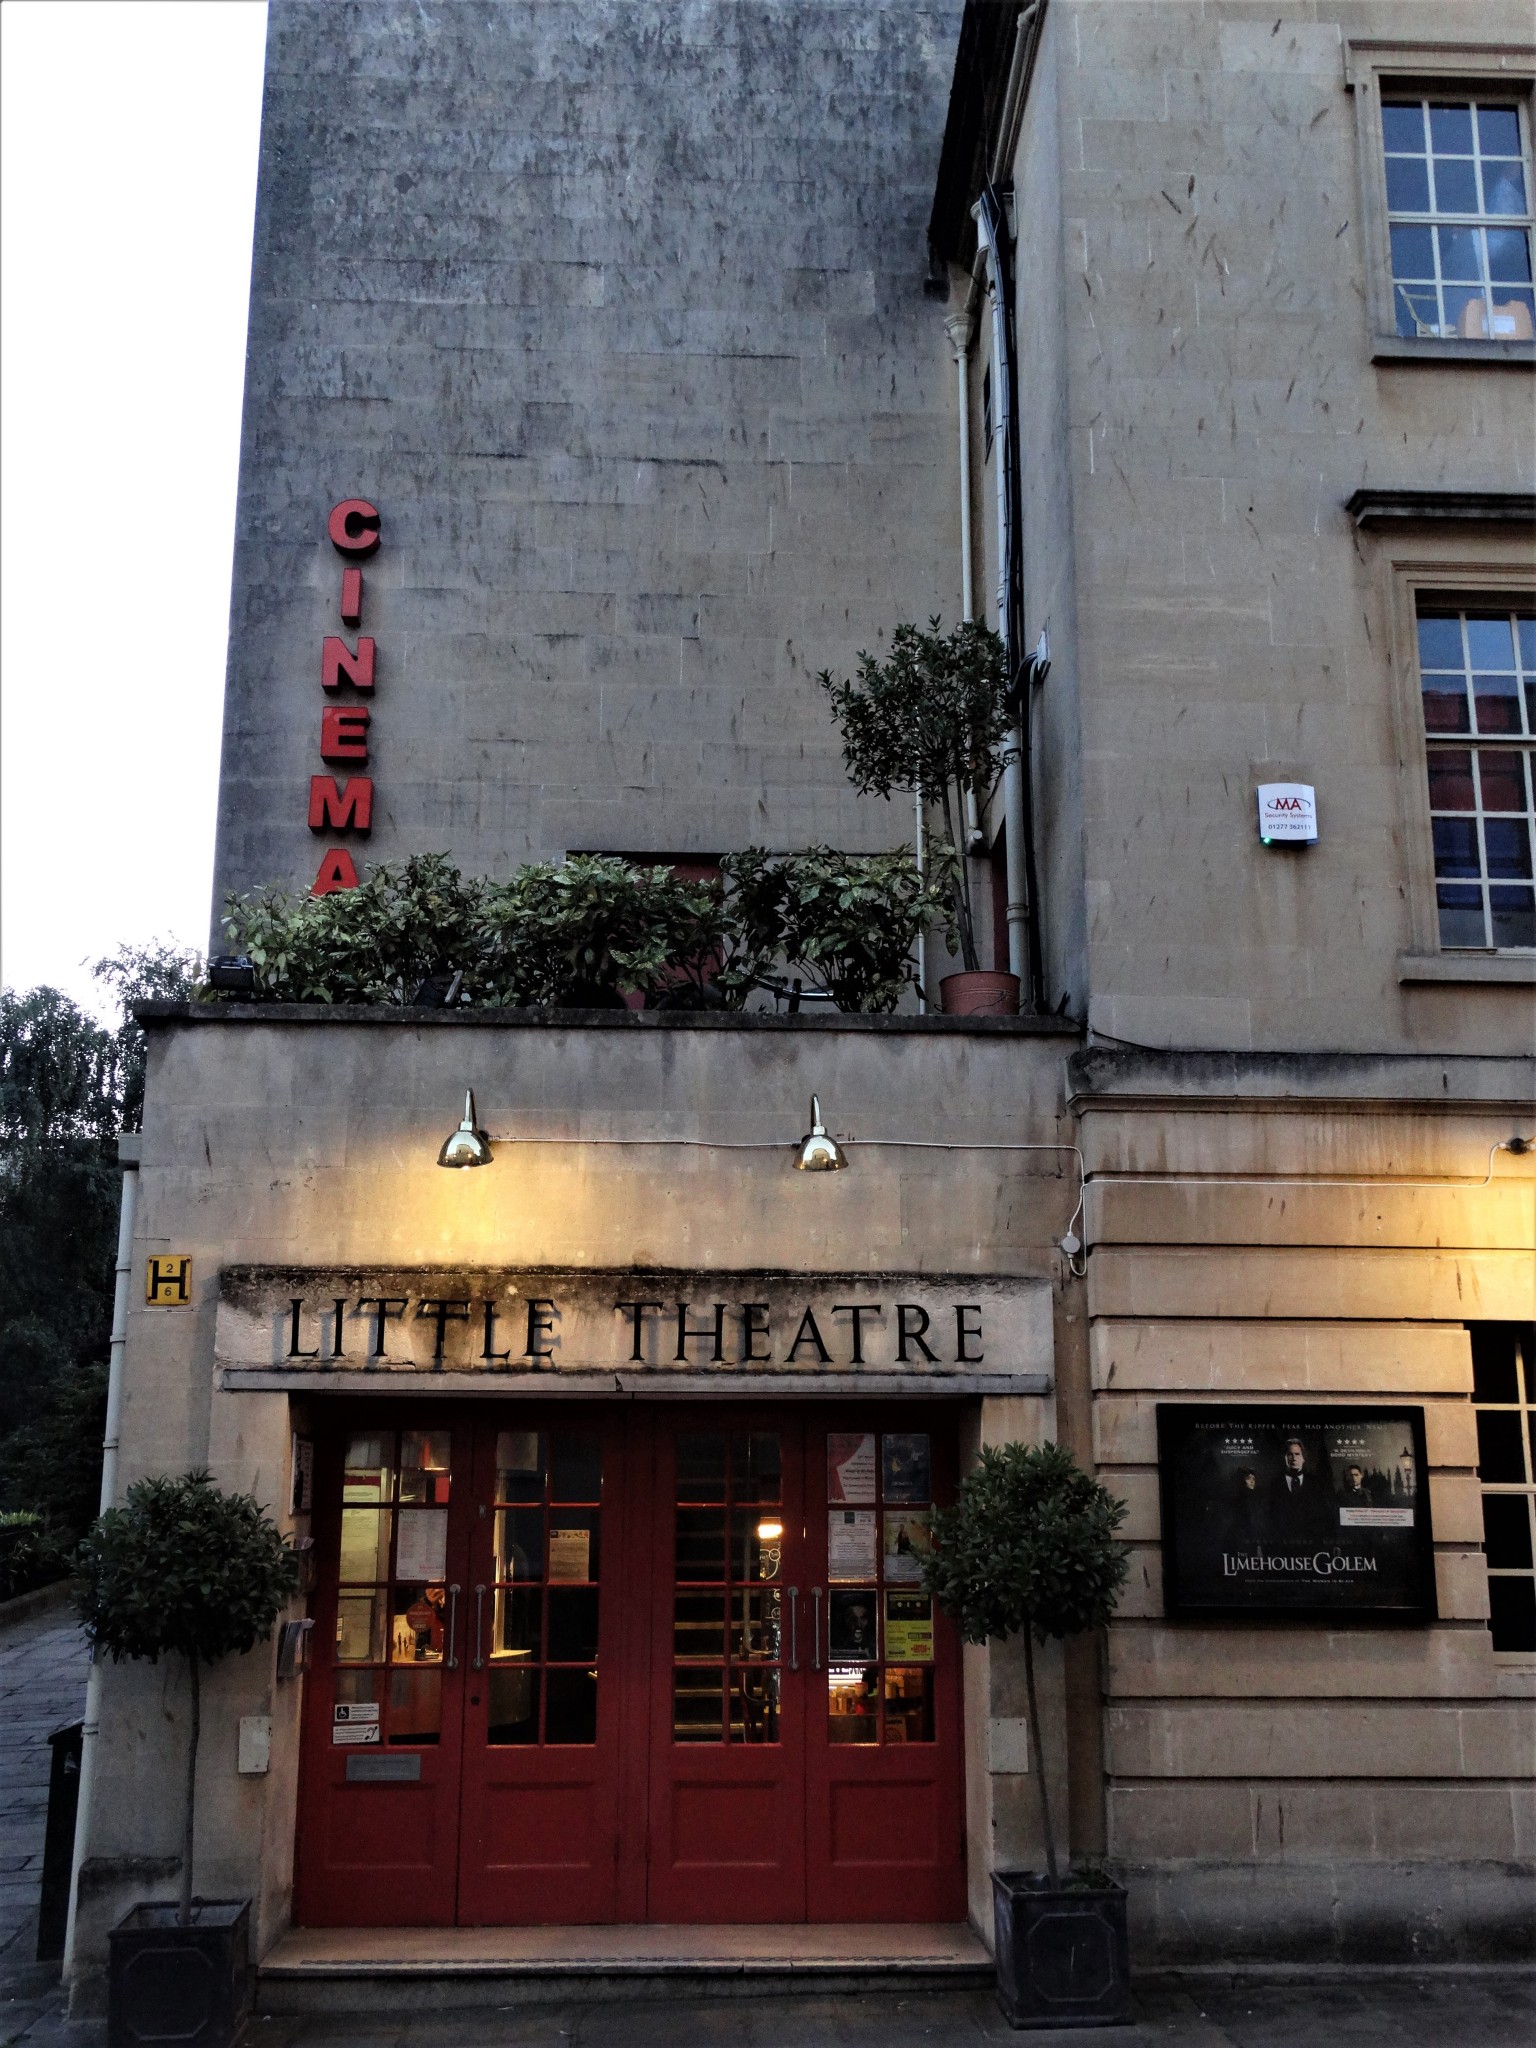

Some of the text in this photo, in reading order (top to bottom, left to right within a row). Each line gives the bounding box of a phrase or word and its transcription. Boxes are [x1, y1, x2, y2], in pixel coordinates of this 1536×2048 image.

[308, 499, 382, 897] CINEMA
[1275, 797, 1302, 811] MA
[1289, 812, 1313, 820] Systems
[166, 1263, 173, 1273] 2
[151, 1260, 187, 1299] H
[164, 1286, 172, 1296] 6
[286, 1298, 986, 1363] LITTLE THEATRE
[1222, 1551, 1378, 1576] LIMEHOUSE GOLEM
